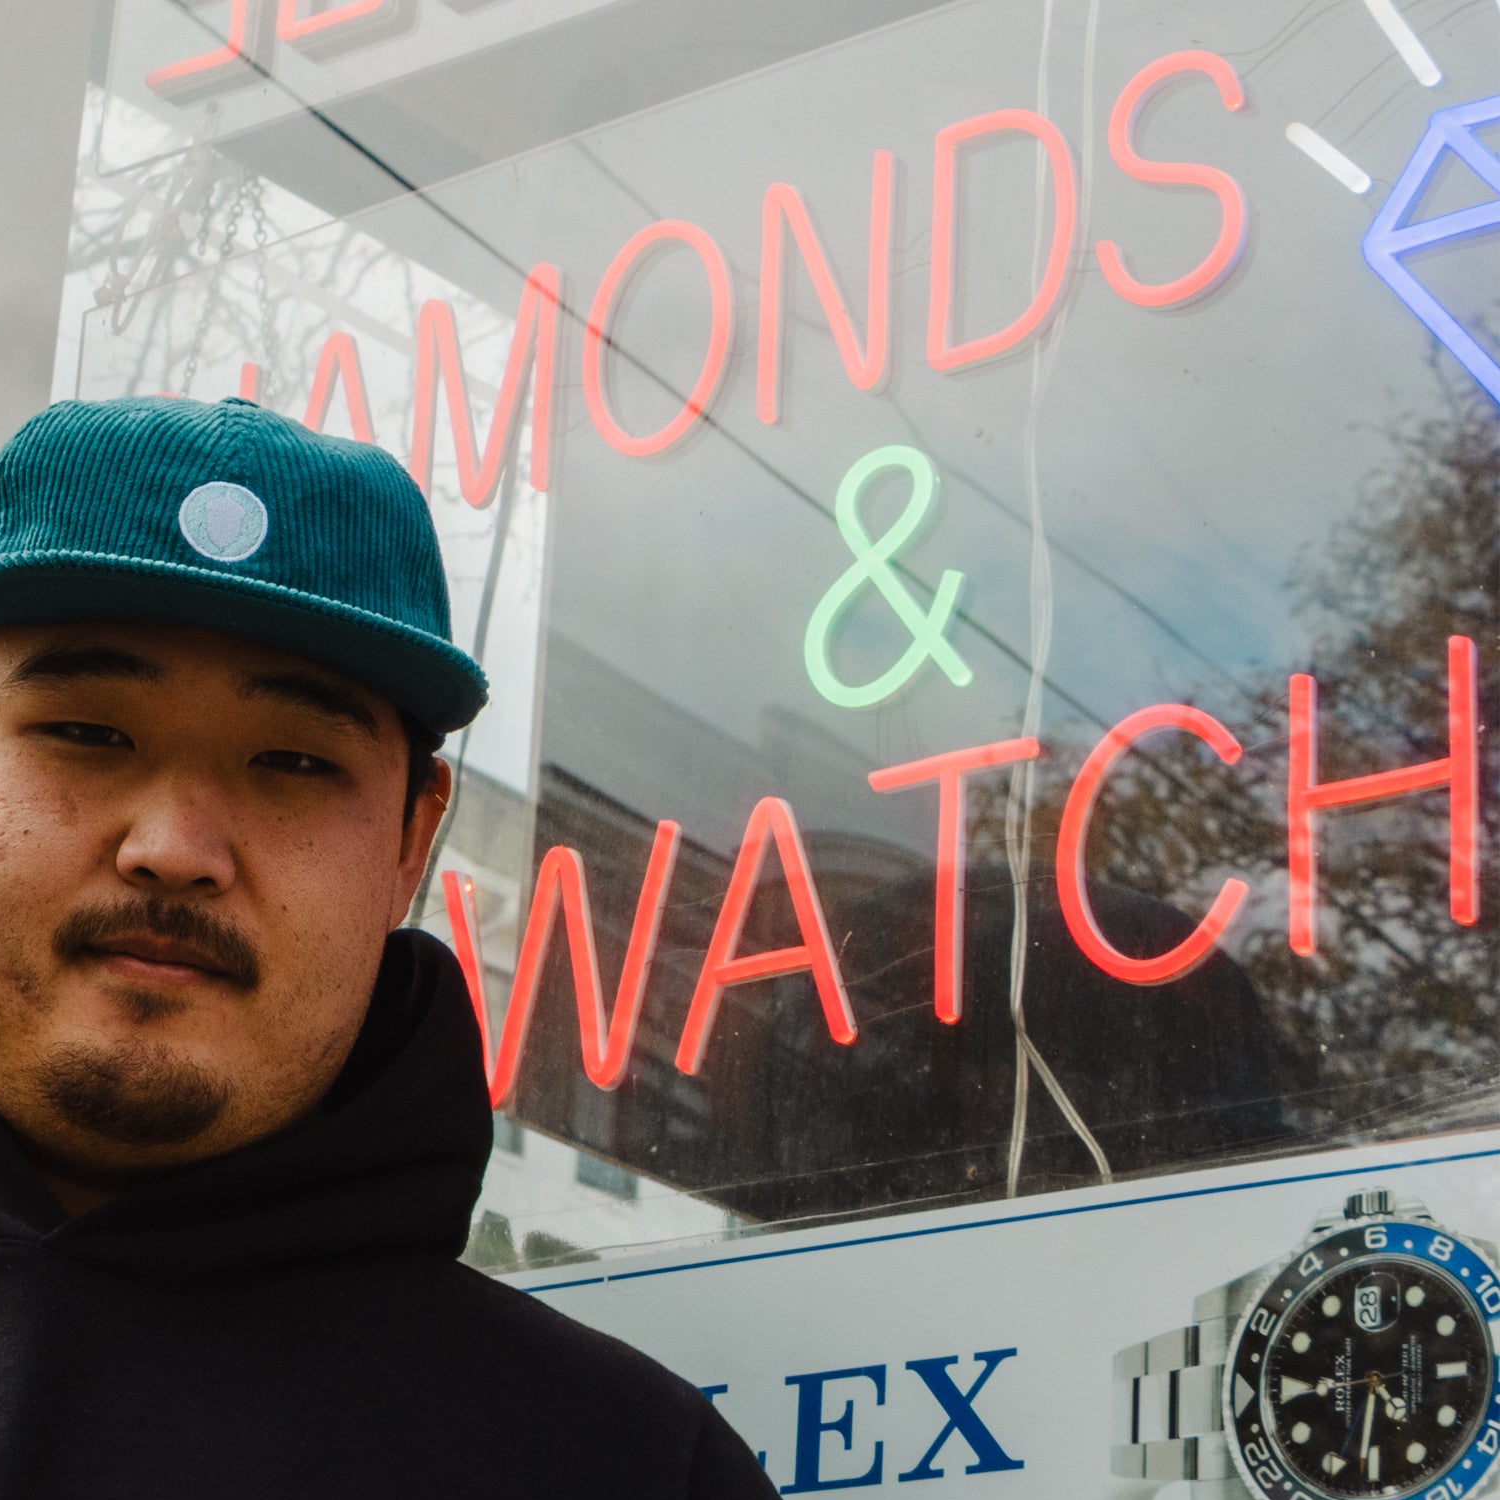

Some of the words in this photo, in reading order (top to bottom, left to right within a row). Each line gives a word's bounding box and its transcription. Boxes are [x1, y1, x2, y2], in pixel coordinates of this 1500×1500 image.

[804, 444, 974, 708] &
[443, 635, 1479, 1110] WATCH
[1364, 1226, 1387, 1248] 6
[1428, 1236, 1454, 1261] 8
[1299, 1252, 1324, 1276] 4
[1359, 1291, 1377, 1324] 28
[1475, 1274, 1500, 1314] 10
[1250, 1307, 1277, 1336] 2
[1245, 1437, 1284, 1489] 22
